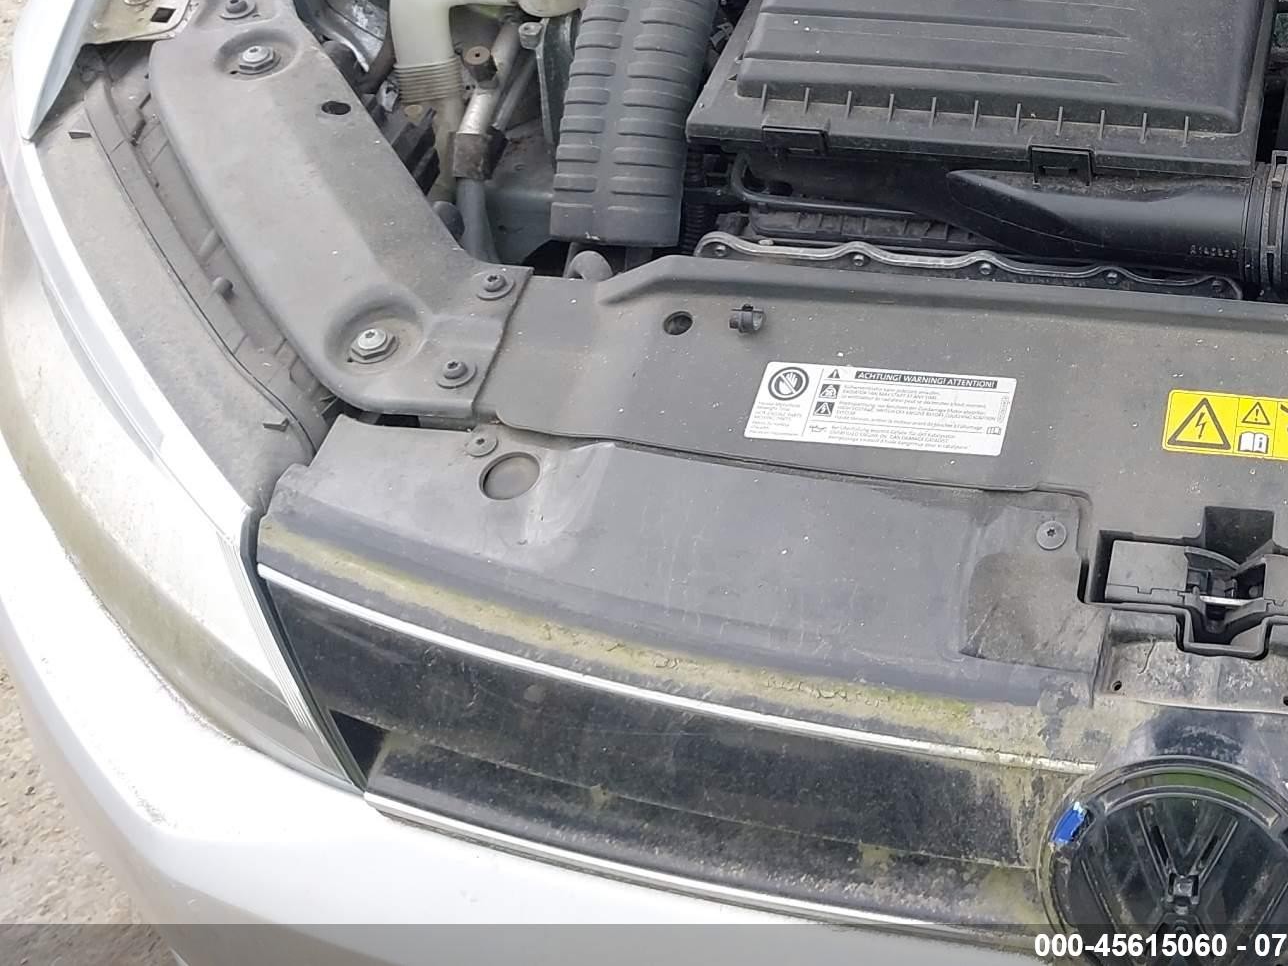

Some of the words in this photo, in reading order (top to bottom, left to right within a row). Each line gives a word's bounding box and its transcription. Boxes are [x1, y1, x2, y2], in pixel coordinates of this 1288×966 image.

[857, 372, 902, 382] ACHTUNG!
[903, 375, 946, 385] WARNING!
[947, 379, 995, 389] ATTENTION!
